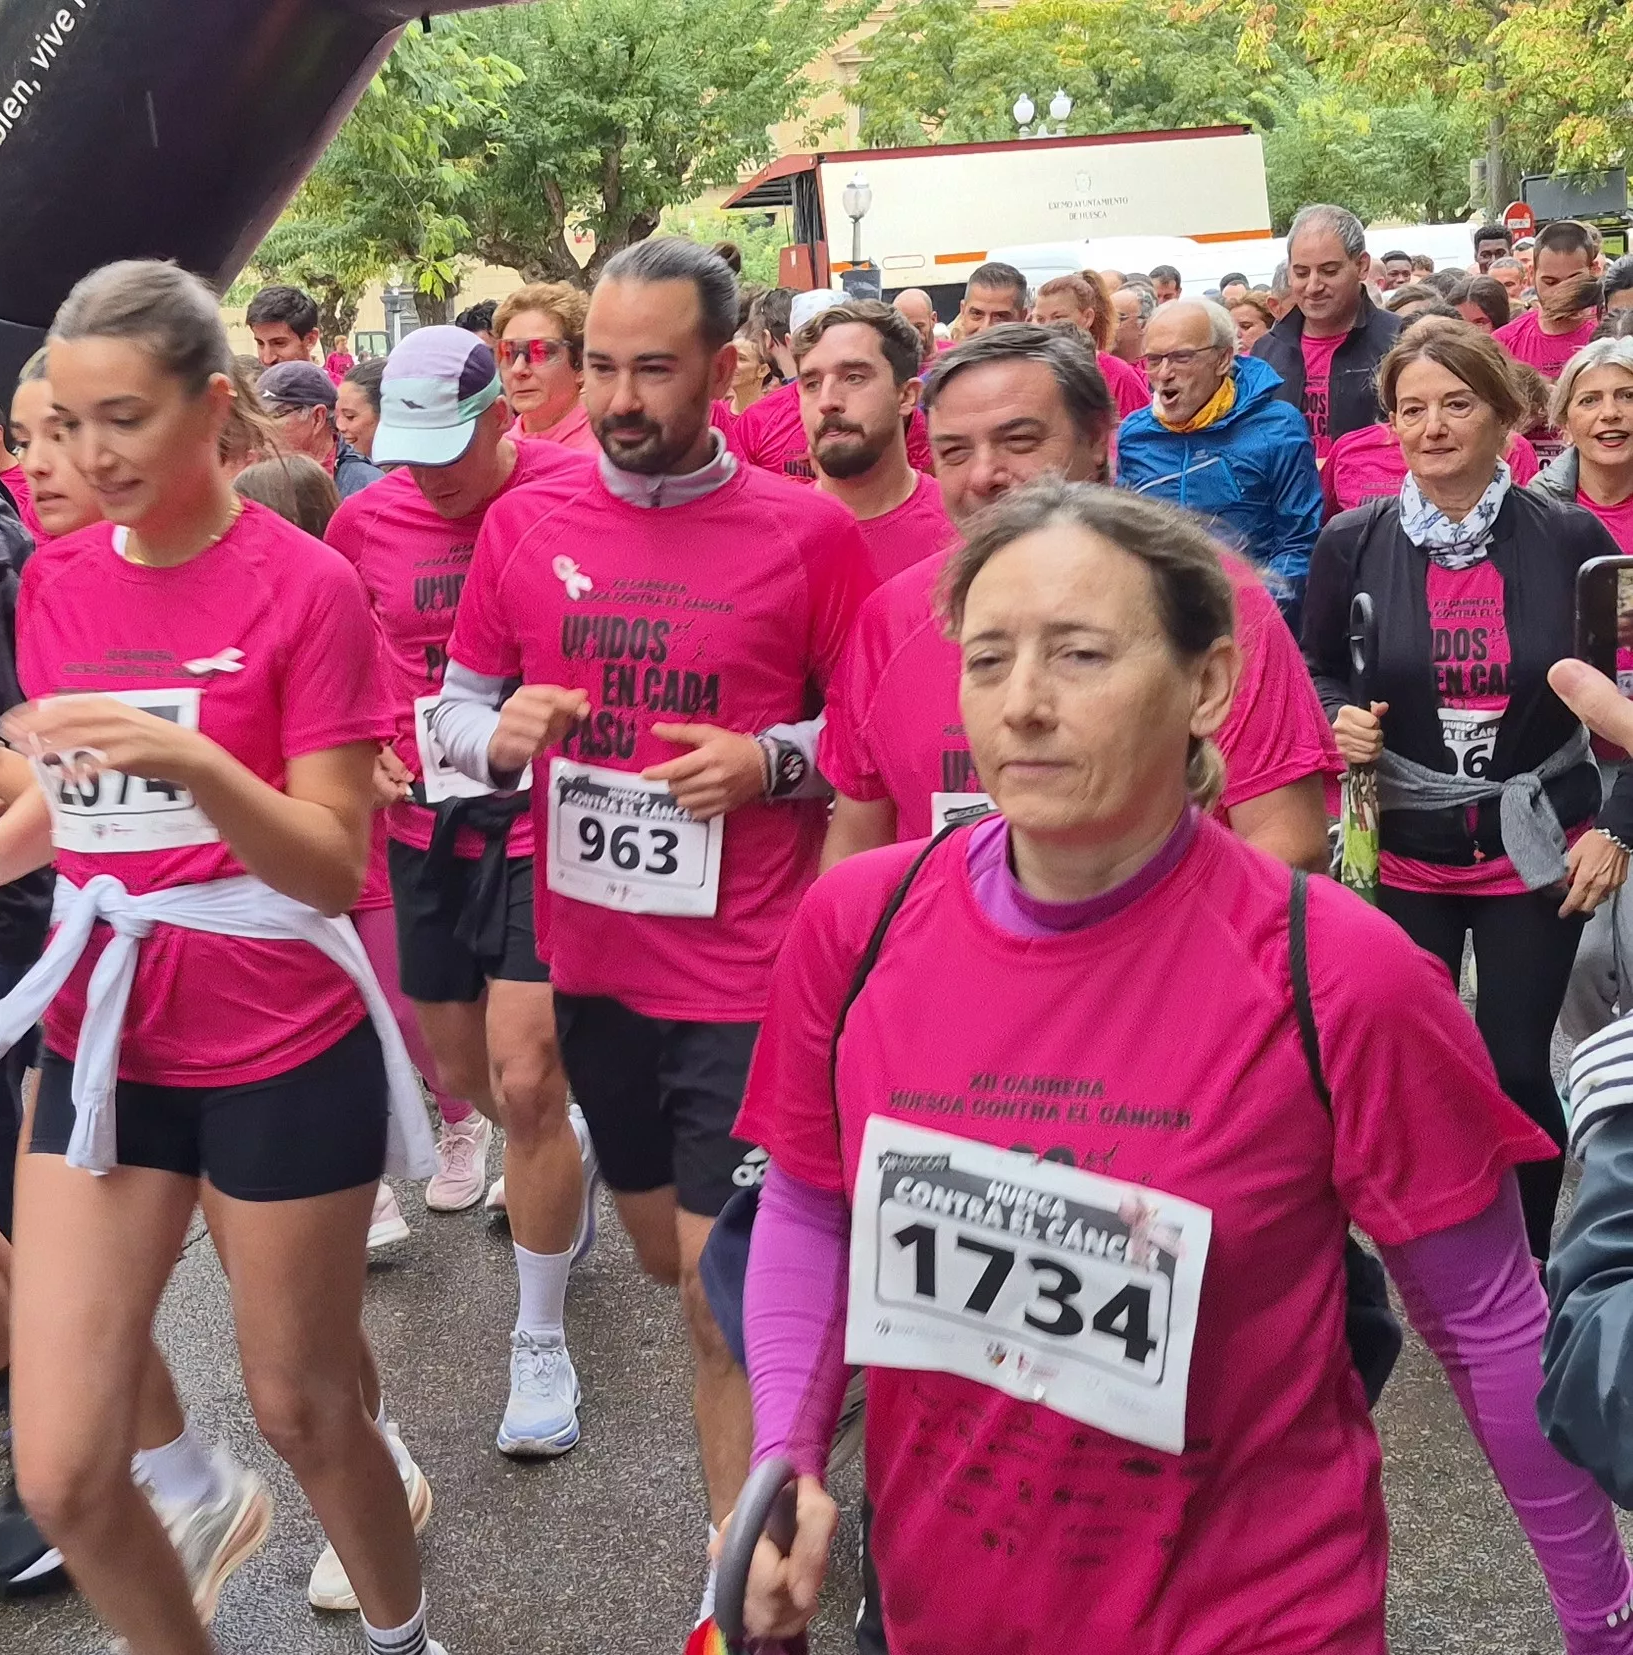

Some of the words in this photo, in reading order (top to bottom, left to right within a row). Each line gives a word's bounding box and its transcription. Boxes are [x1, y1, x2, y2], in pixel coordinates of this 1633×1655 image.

[30, 8, 75, 71] vive
[601, 663, 637, 707] EN
[644, 666, 720, 716] CADA
[579, 816, 679, 875] 963
[889, 1091, 964, 1115] HUESCA
[973, 1098, 1060, 1123] CONTRA
[1066, 1105, 1090, 1125] EL
[1099, 1106, 1191, 1132] CÁNCER
[1002, 1076, 1106, 1099] CARRERA
[893, 1175, 1005, 1231] CONTRA
[1009, 1208, 1041, 1241] EL
[985, 1179, 1067, 1222] HUESCA
[894, 1224, 1158, 1365] 1734
